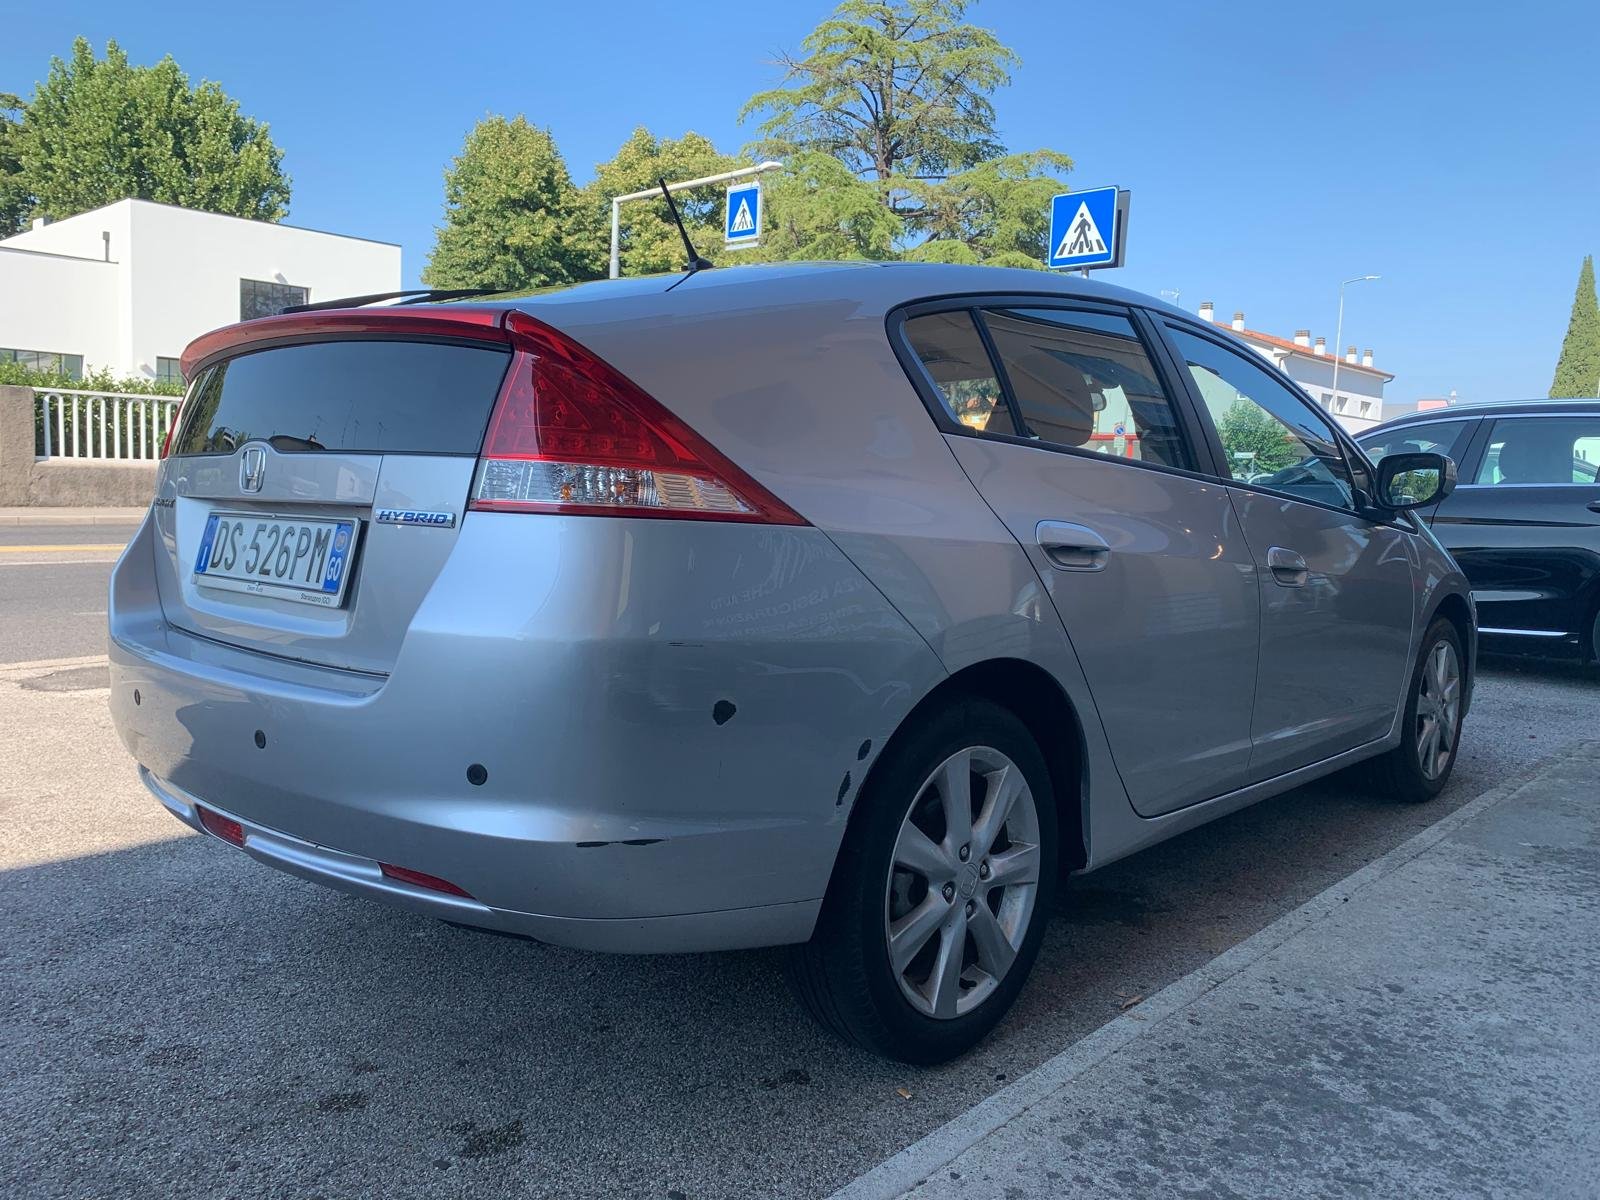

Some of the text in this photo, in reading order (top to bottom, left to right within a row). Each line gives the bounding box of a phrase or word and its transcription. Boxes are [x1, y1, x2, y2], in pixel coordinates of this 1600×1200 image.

[379, 510, 448, 524] HYBRID
[210, 520, 332, 583] DS 526PM
[327, 556, 343, 582] GO
